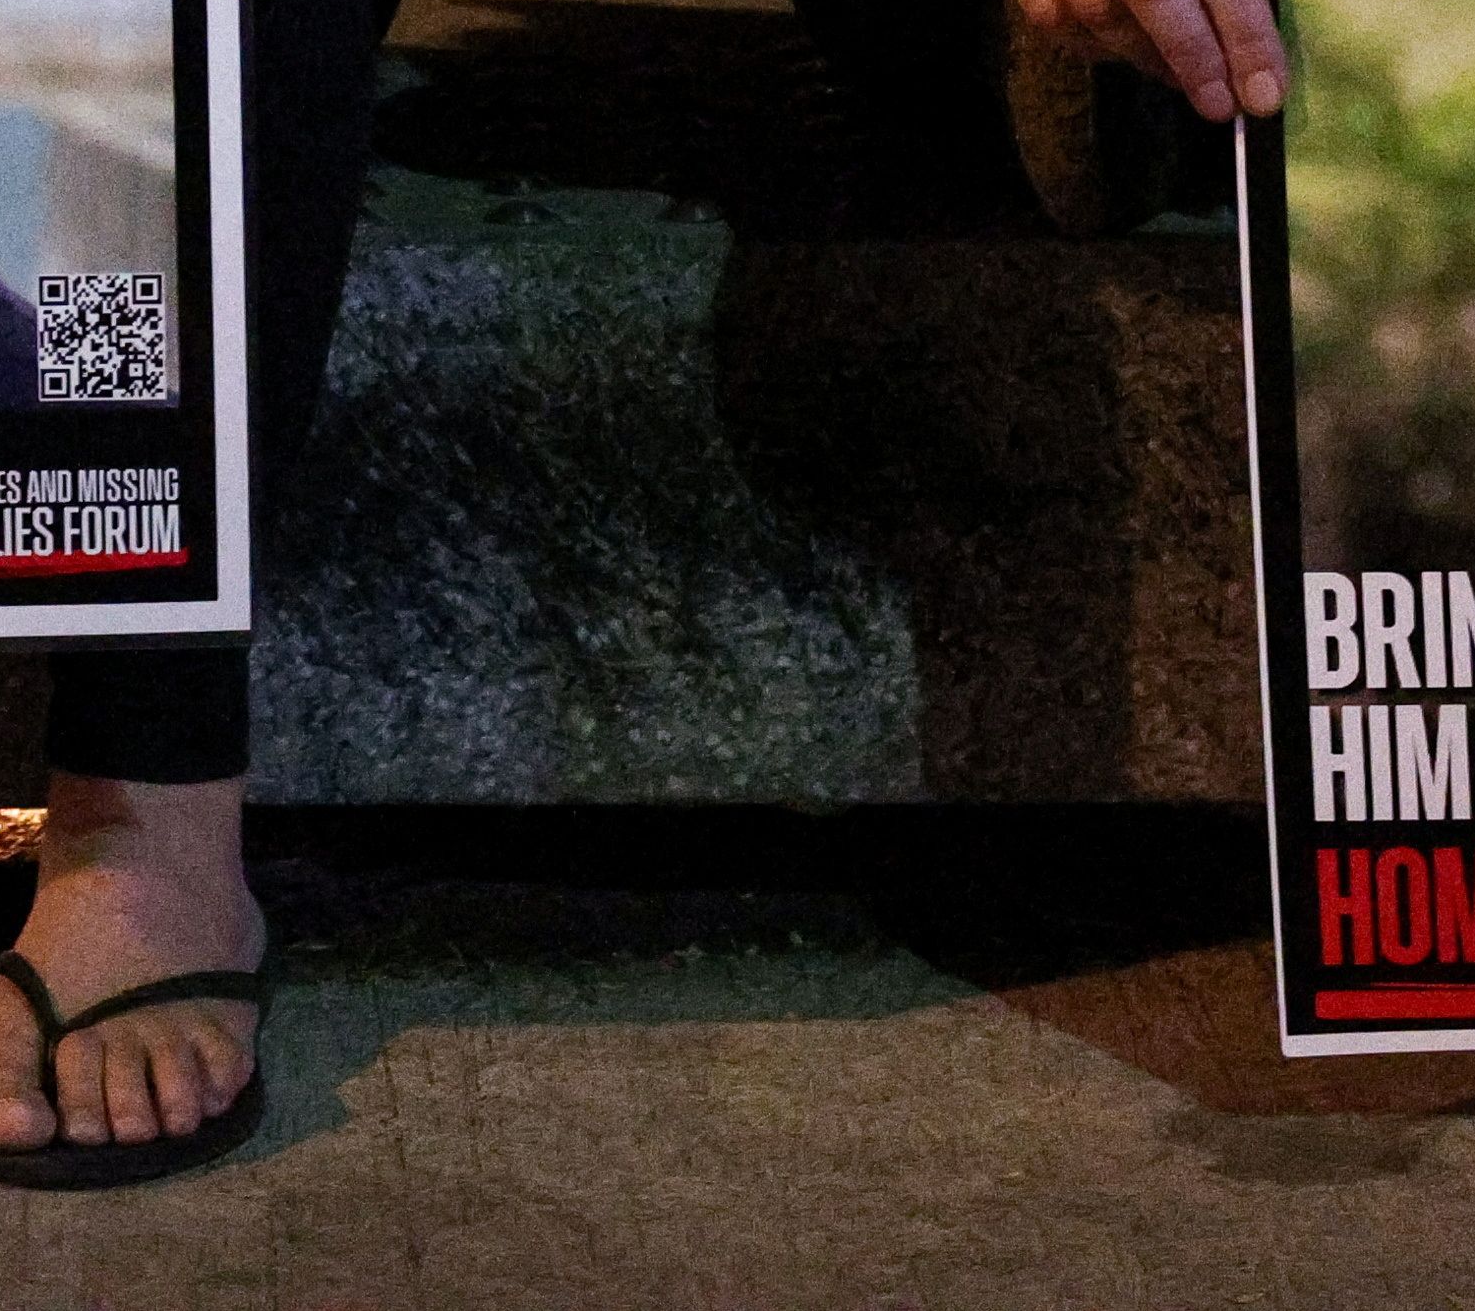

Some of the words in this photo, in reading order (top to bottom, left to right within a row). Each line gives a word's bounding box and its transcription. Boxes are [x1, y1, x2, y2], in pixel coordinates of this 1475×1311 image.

[27, 470, 72, 503] AND
[78, 467, 179, 502] MISSING
[64, 504, 180, 556] FORUM
[1310, 704, 1471, 822] HIM
